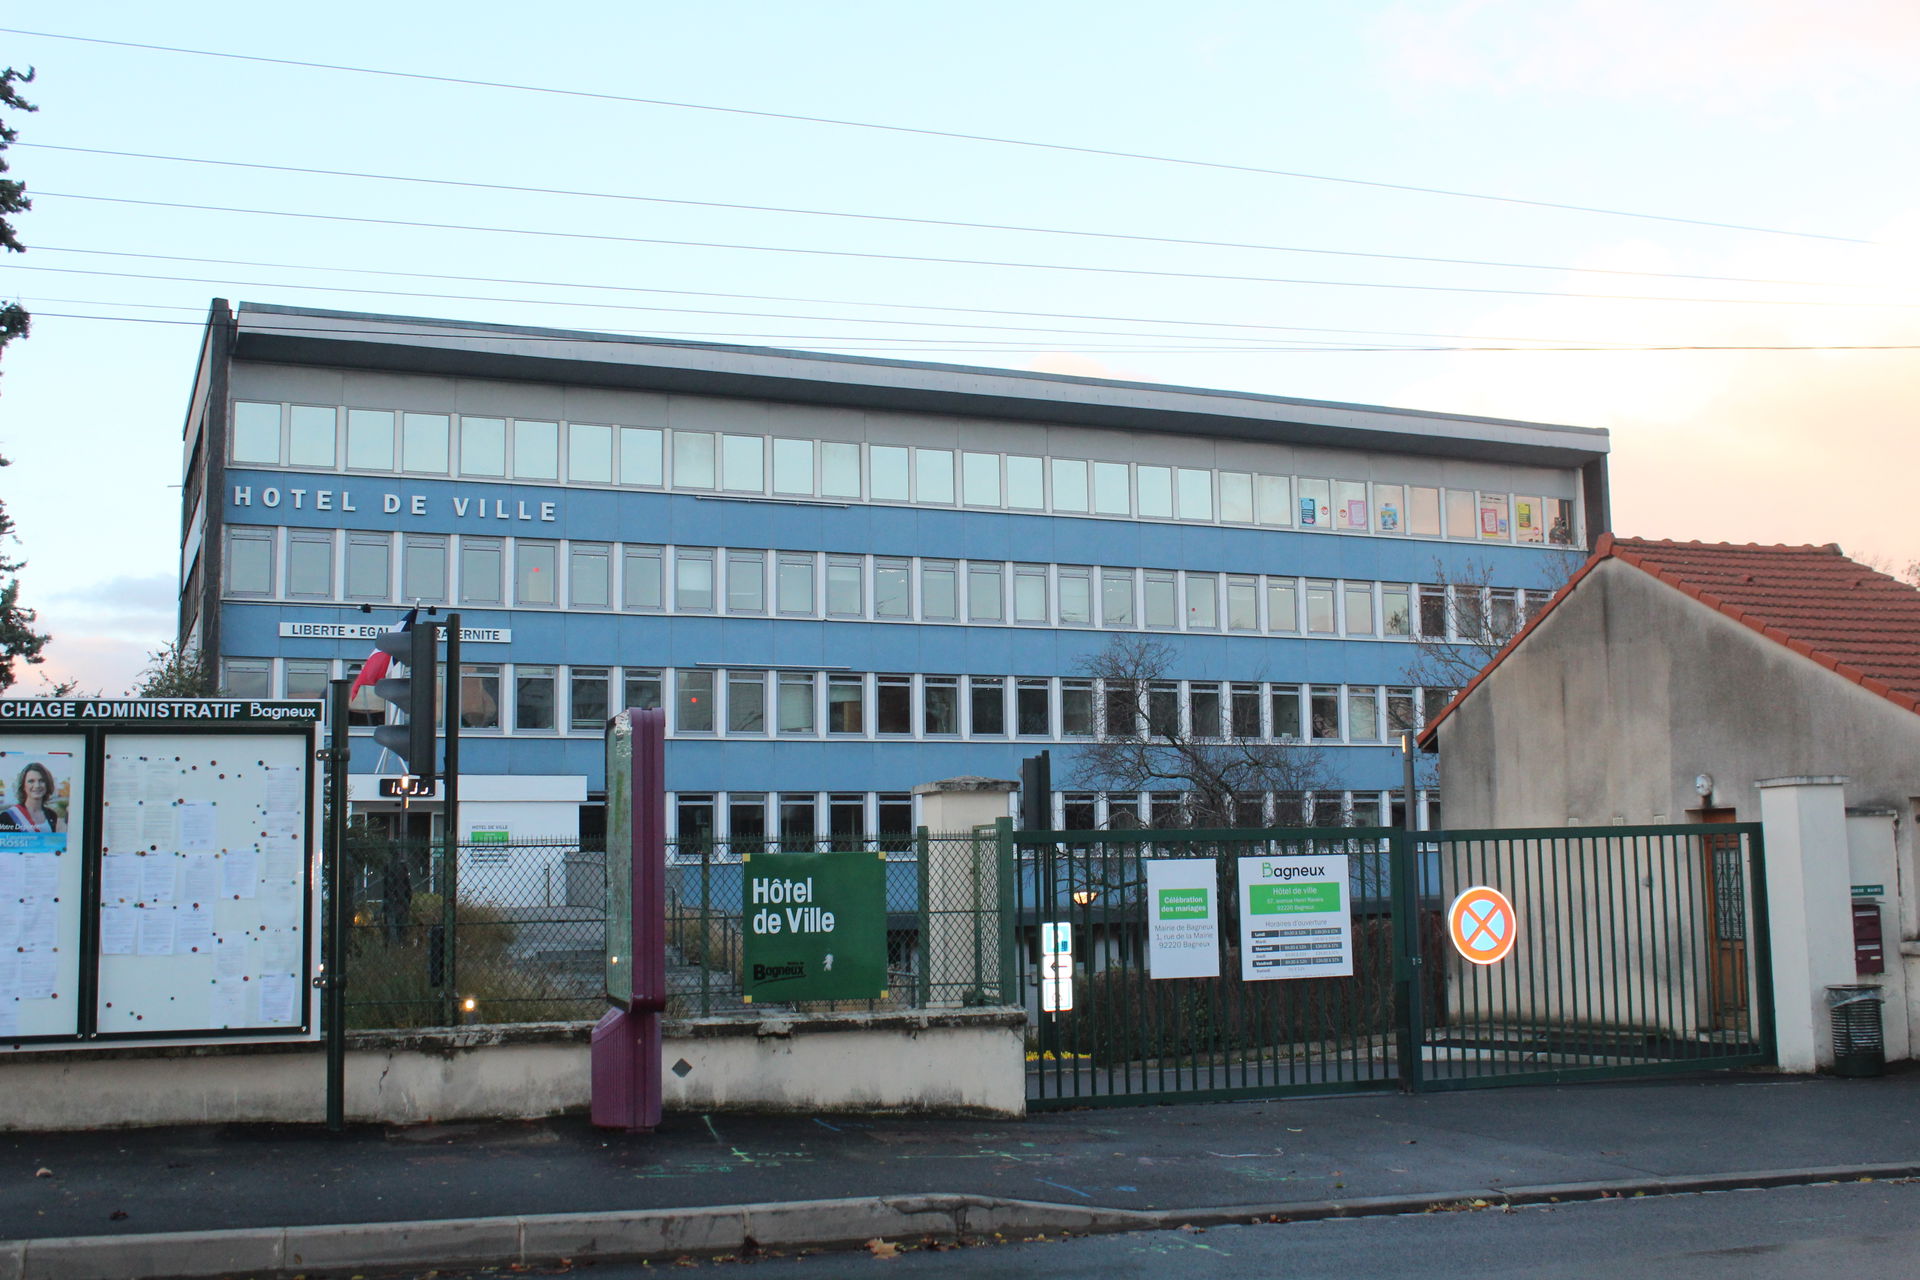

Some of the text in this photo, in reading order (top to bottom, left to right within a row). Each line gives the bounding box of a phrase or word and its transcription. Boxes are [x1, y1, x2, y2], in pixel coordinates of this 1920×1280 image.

[234, 486, 556, 522] HOTEL DE VILLE
[292, 624, 345, 636] LIBERTE
[1, 702, 316, 720] CHAGE ADMINISTRATIF Bagneux
[1262, 862, 1325, 880] Bagneux
[753, 877, 812, 904] Hôtel
[1272, 887, 1292, 895] Hôtel
[1292, 887, 1302, 895] de
[1164, 896, 1203, 904] Célébration
[1176, 905, 1206, 913] mariages
[753, 907, 835, 934] de Ville
